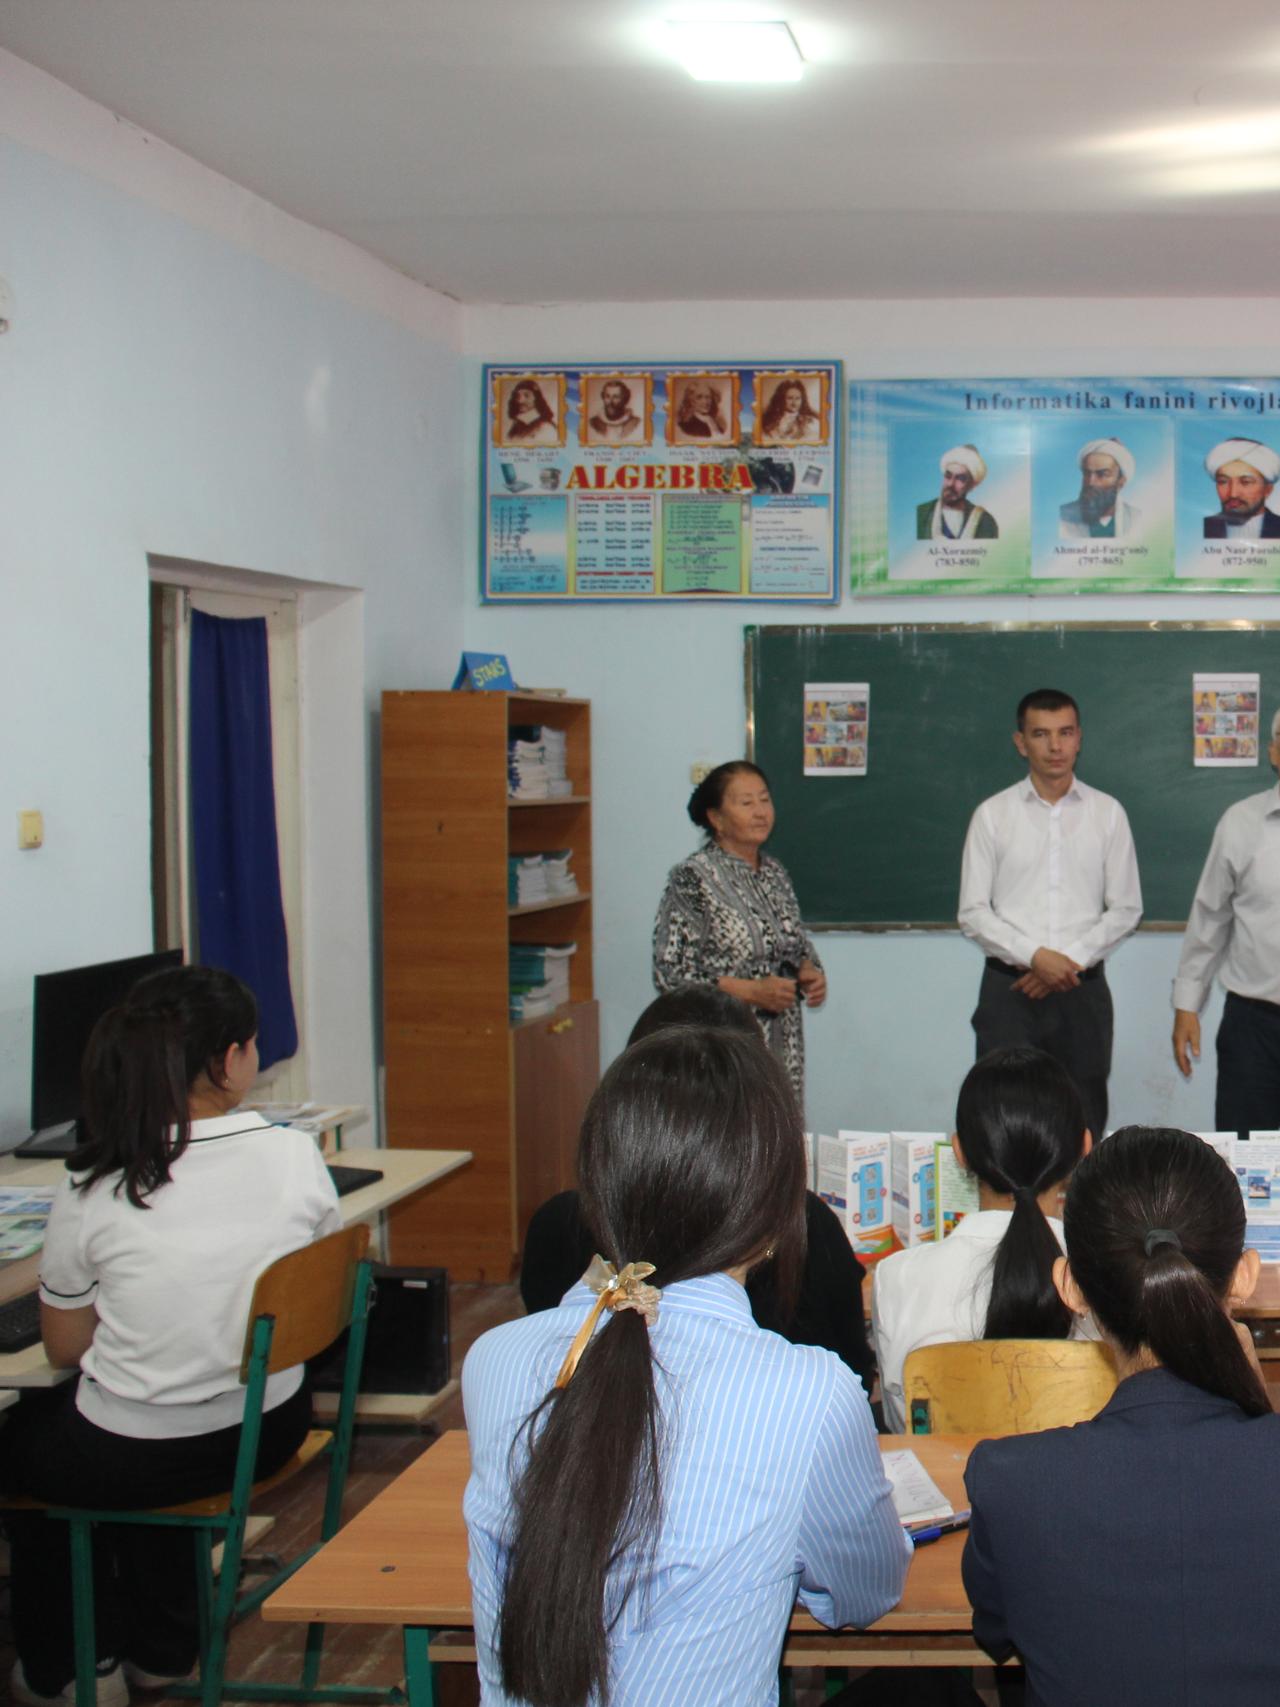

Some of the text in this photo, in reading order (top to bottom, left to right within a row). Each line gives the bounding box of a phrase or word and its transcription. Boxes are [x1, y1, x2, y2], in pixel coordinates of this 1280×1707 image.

[965, 391, 1111, 411] Informatika
[1124, 391, 1196, 410] fanini
[567, 464, 755, 489] ALGEBRA
